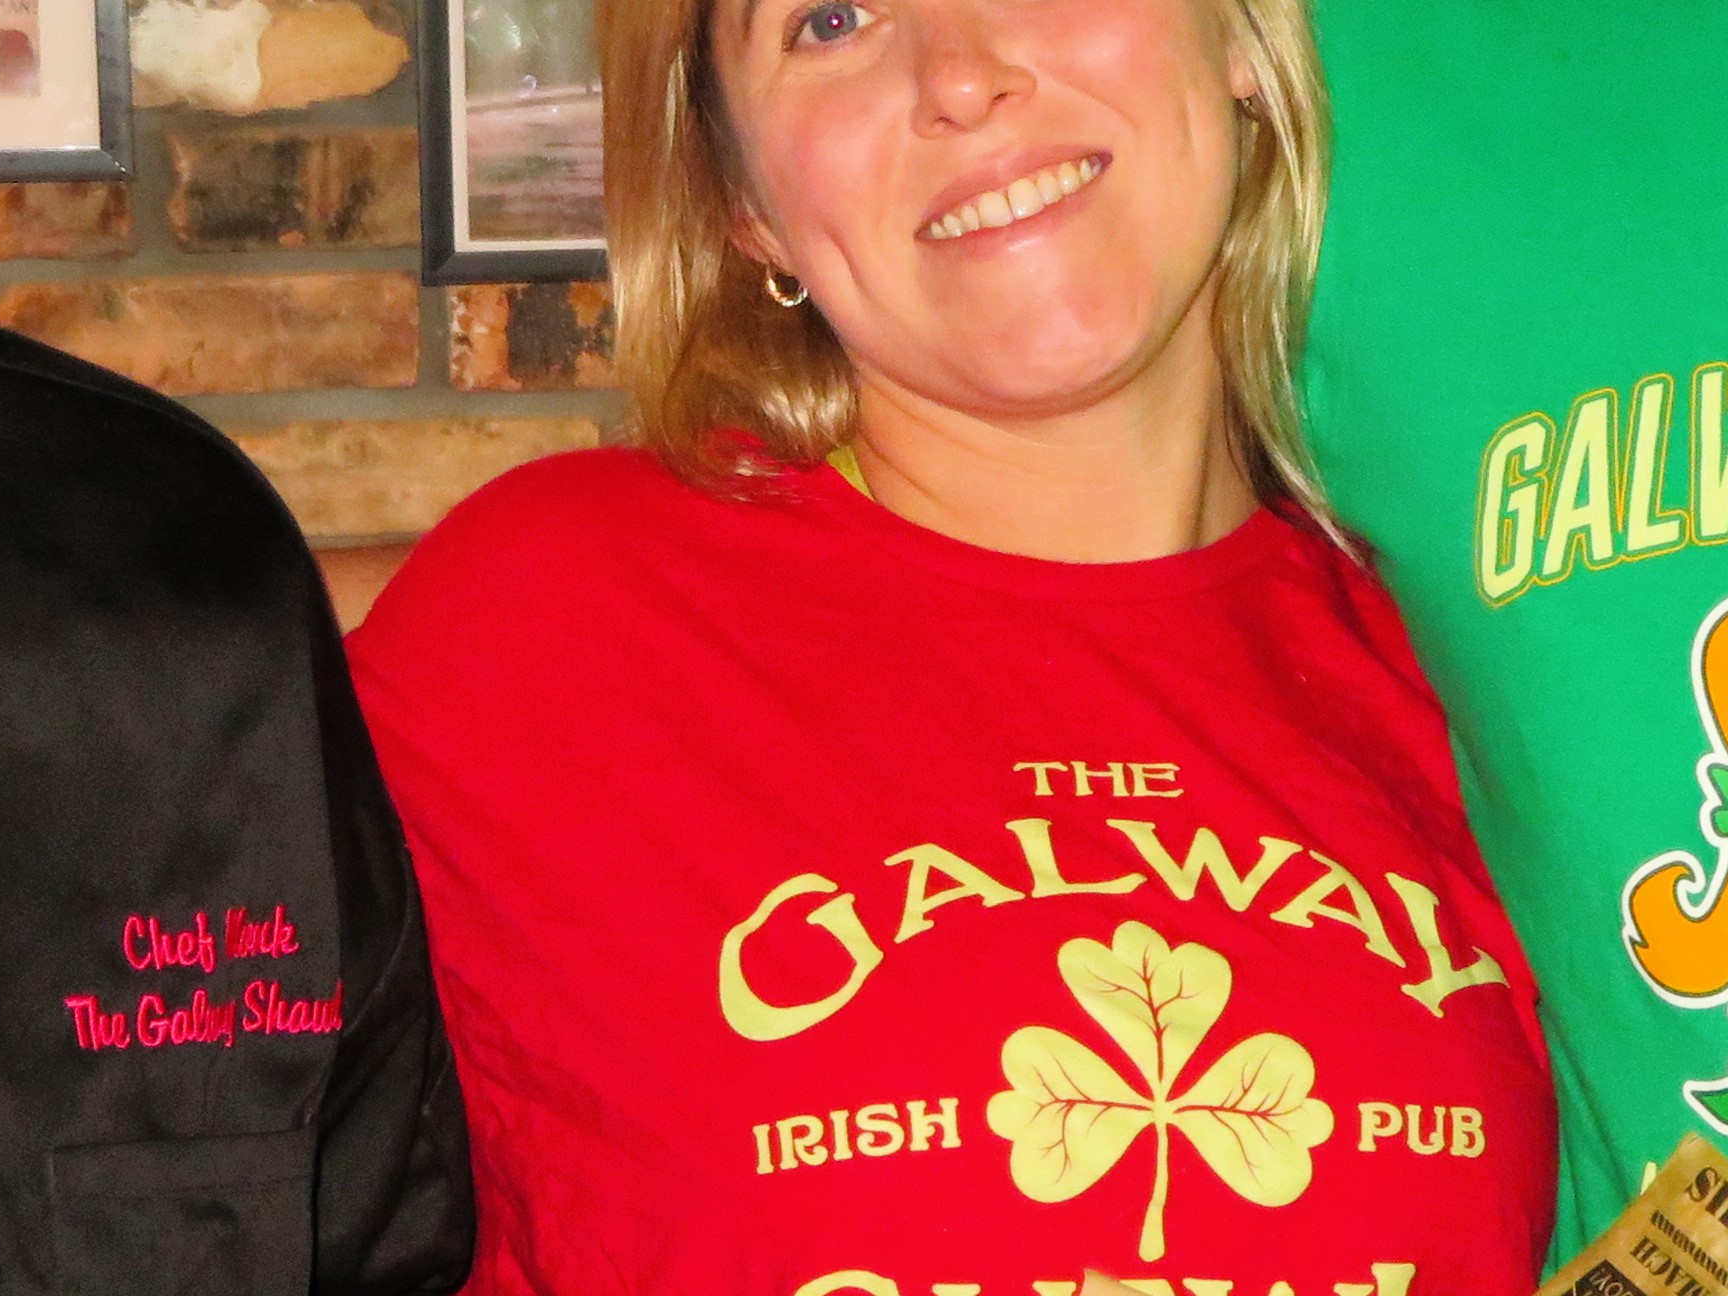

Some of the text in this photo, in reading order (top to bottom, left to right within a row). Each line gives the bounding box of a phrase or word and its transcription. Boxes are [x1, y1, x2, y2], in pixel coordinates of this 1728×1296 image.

[1012, 760, 1184, 799] THE
[123, 910, 217, 974] Chef
[718, 817, 1511, 1042] GALWAY
[64, 992, 132, 1052] The
[752, 1098, 1487, 1175] IRISH PUB
